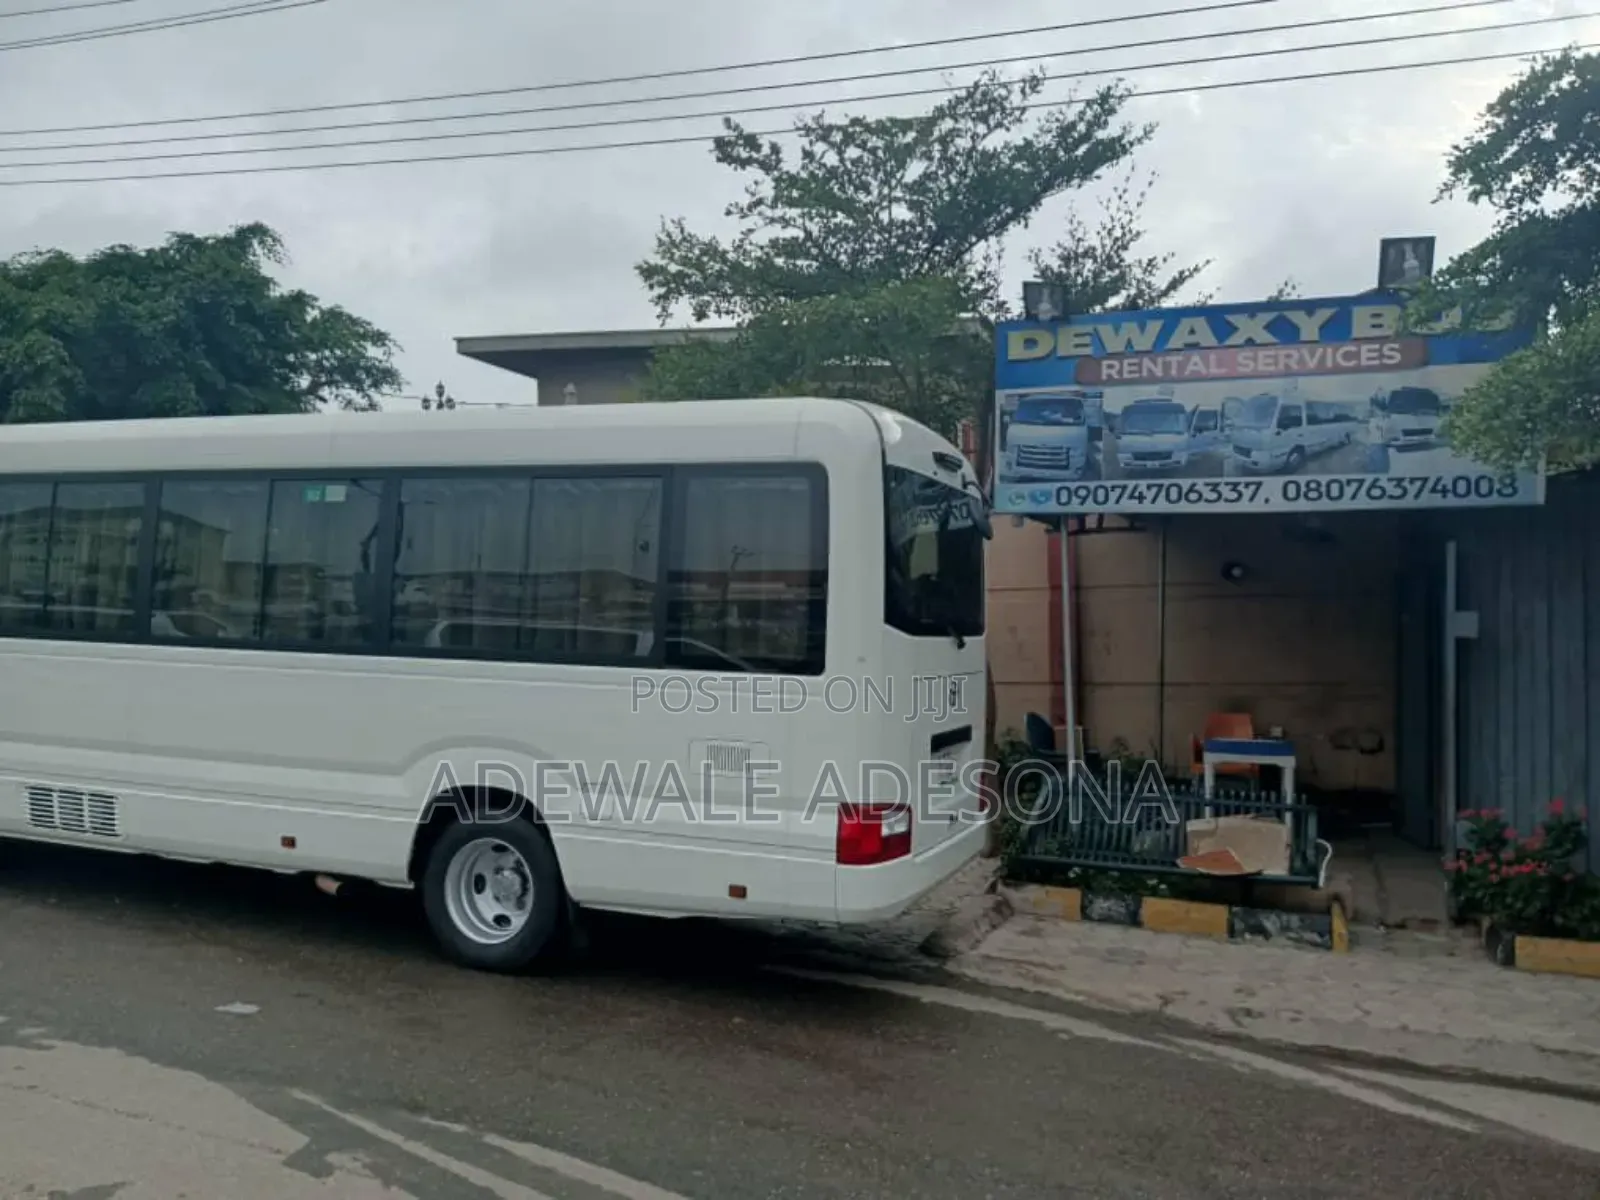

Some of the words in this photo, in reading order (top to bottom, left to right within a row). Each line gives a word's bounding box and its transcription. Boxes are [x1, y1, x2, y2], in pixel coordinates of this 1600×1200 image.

[1007, 308, 1339, 361] DEWAXY
[1101, 353, 1227, 381] RENTAL
[1236, 342, 1402, 375] SERVICES
[1282, 474, 1519, 502] 08076374008
